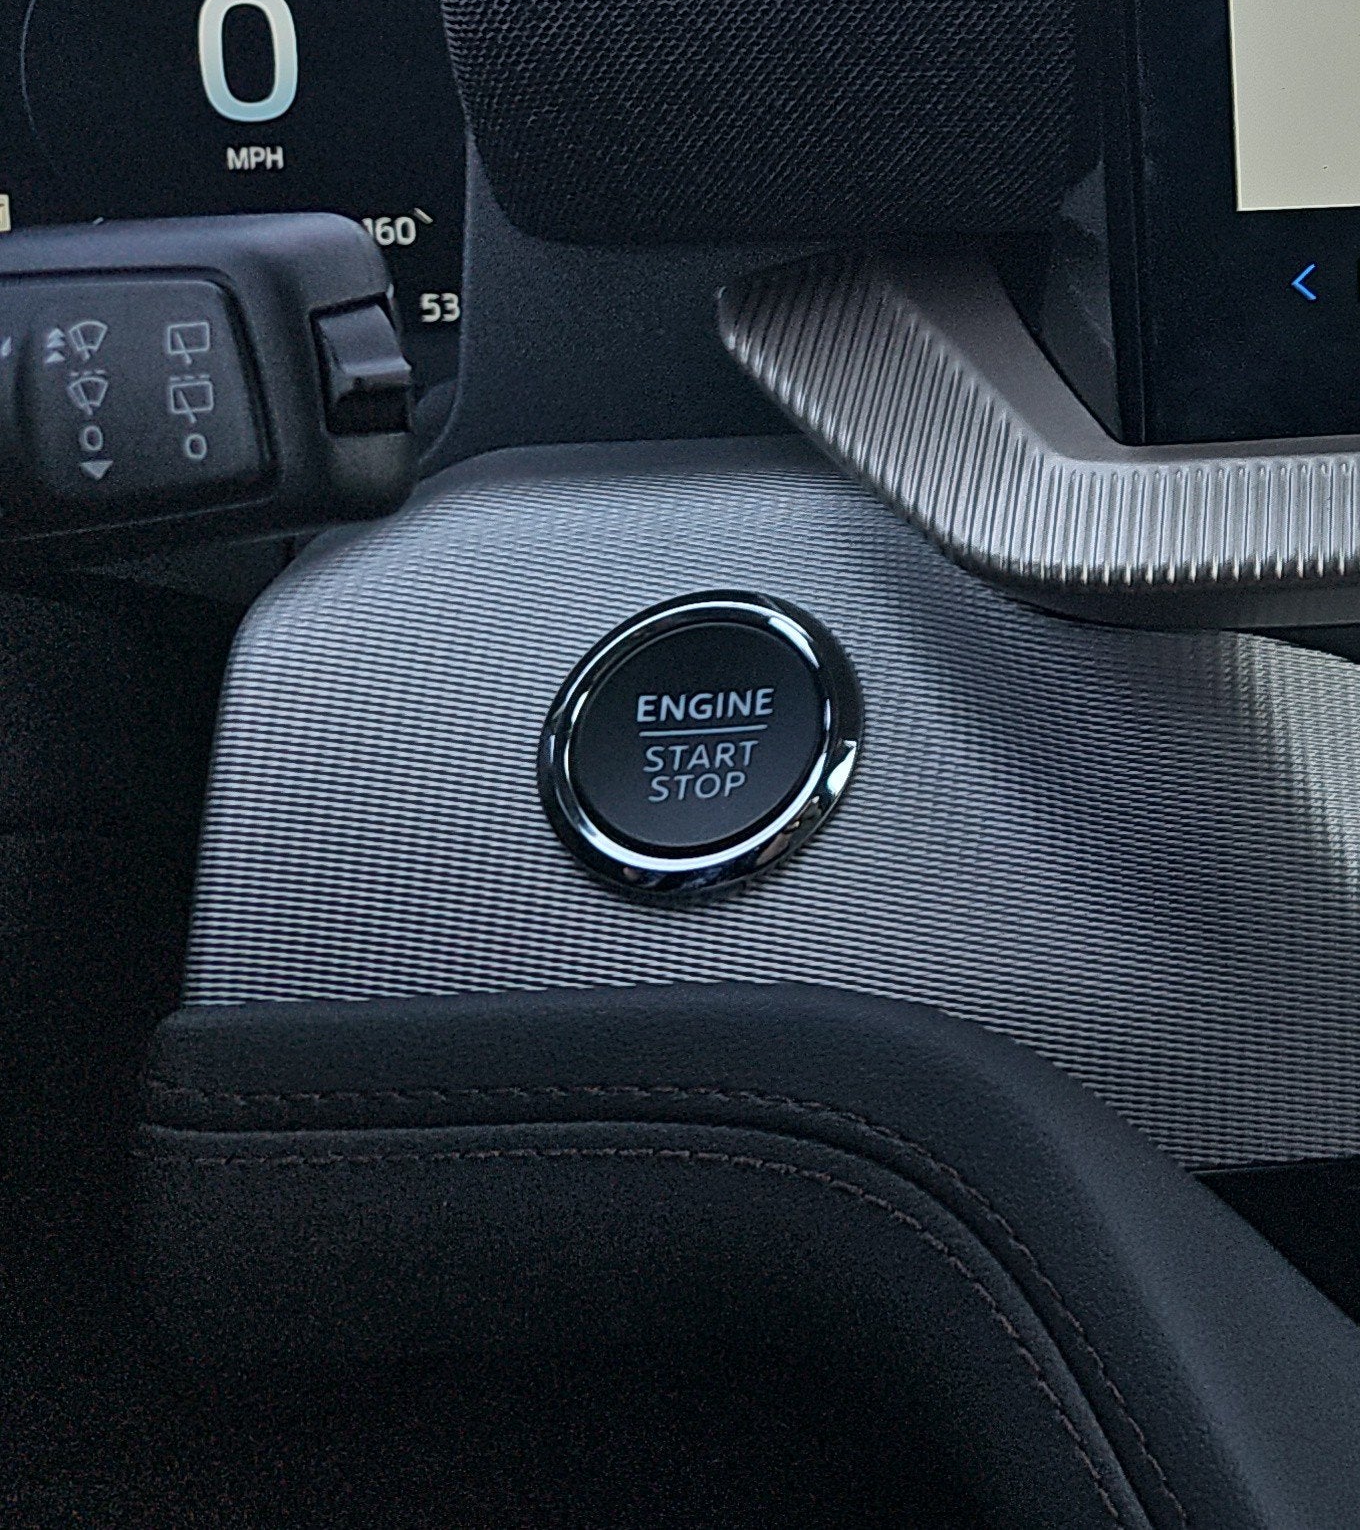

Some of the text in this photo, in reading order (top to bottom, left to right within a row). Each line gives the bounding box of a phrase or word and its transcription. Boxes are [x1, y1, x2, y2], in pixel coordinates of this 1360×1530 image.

[226, 146, 285, 171] MPH
[420, 292, 461, 323] 53
[636, 687, 775, 722] ENGINE
[643, 739, 760, 773] START
[648, 771, 746, 802] STOP
